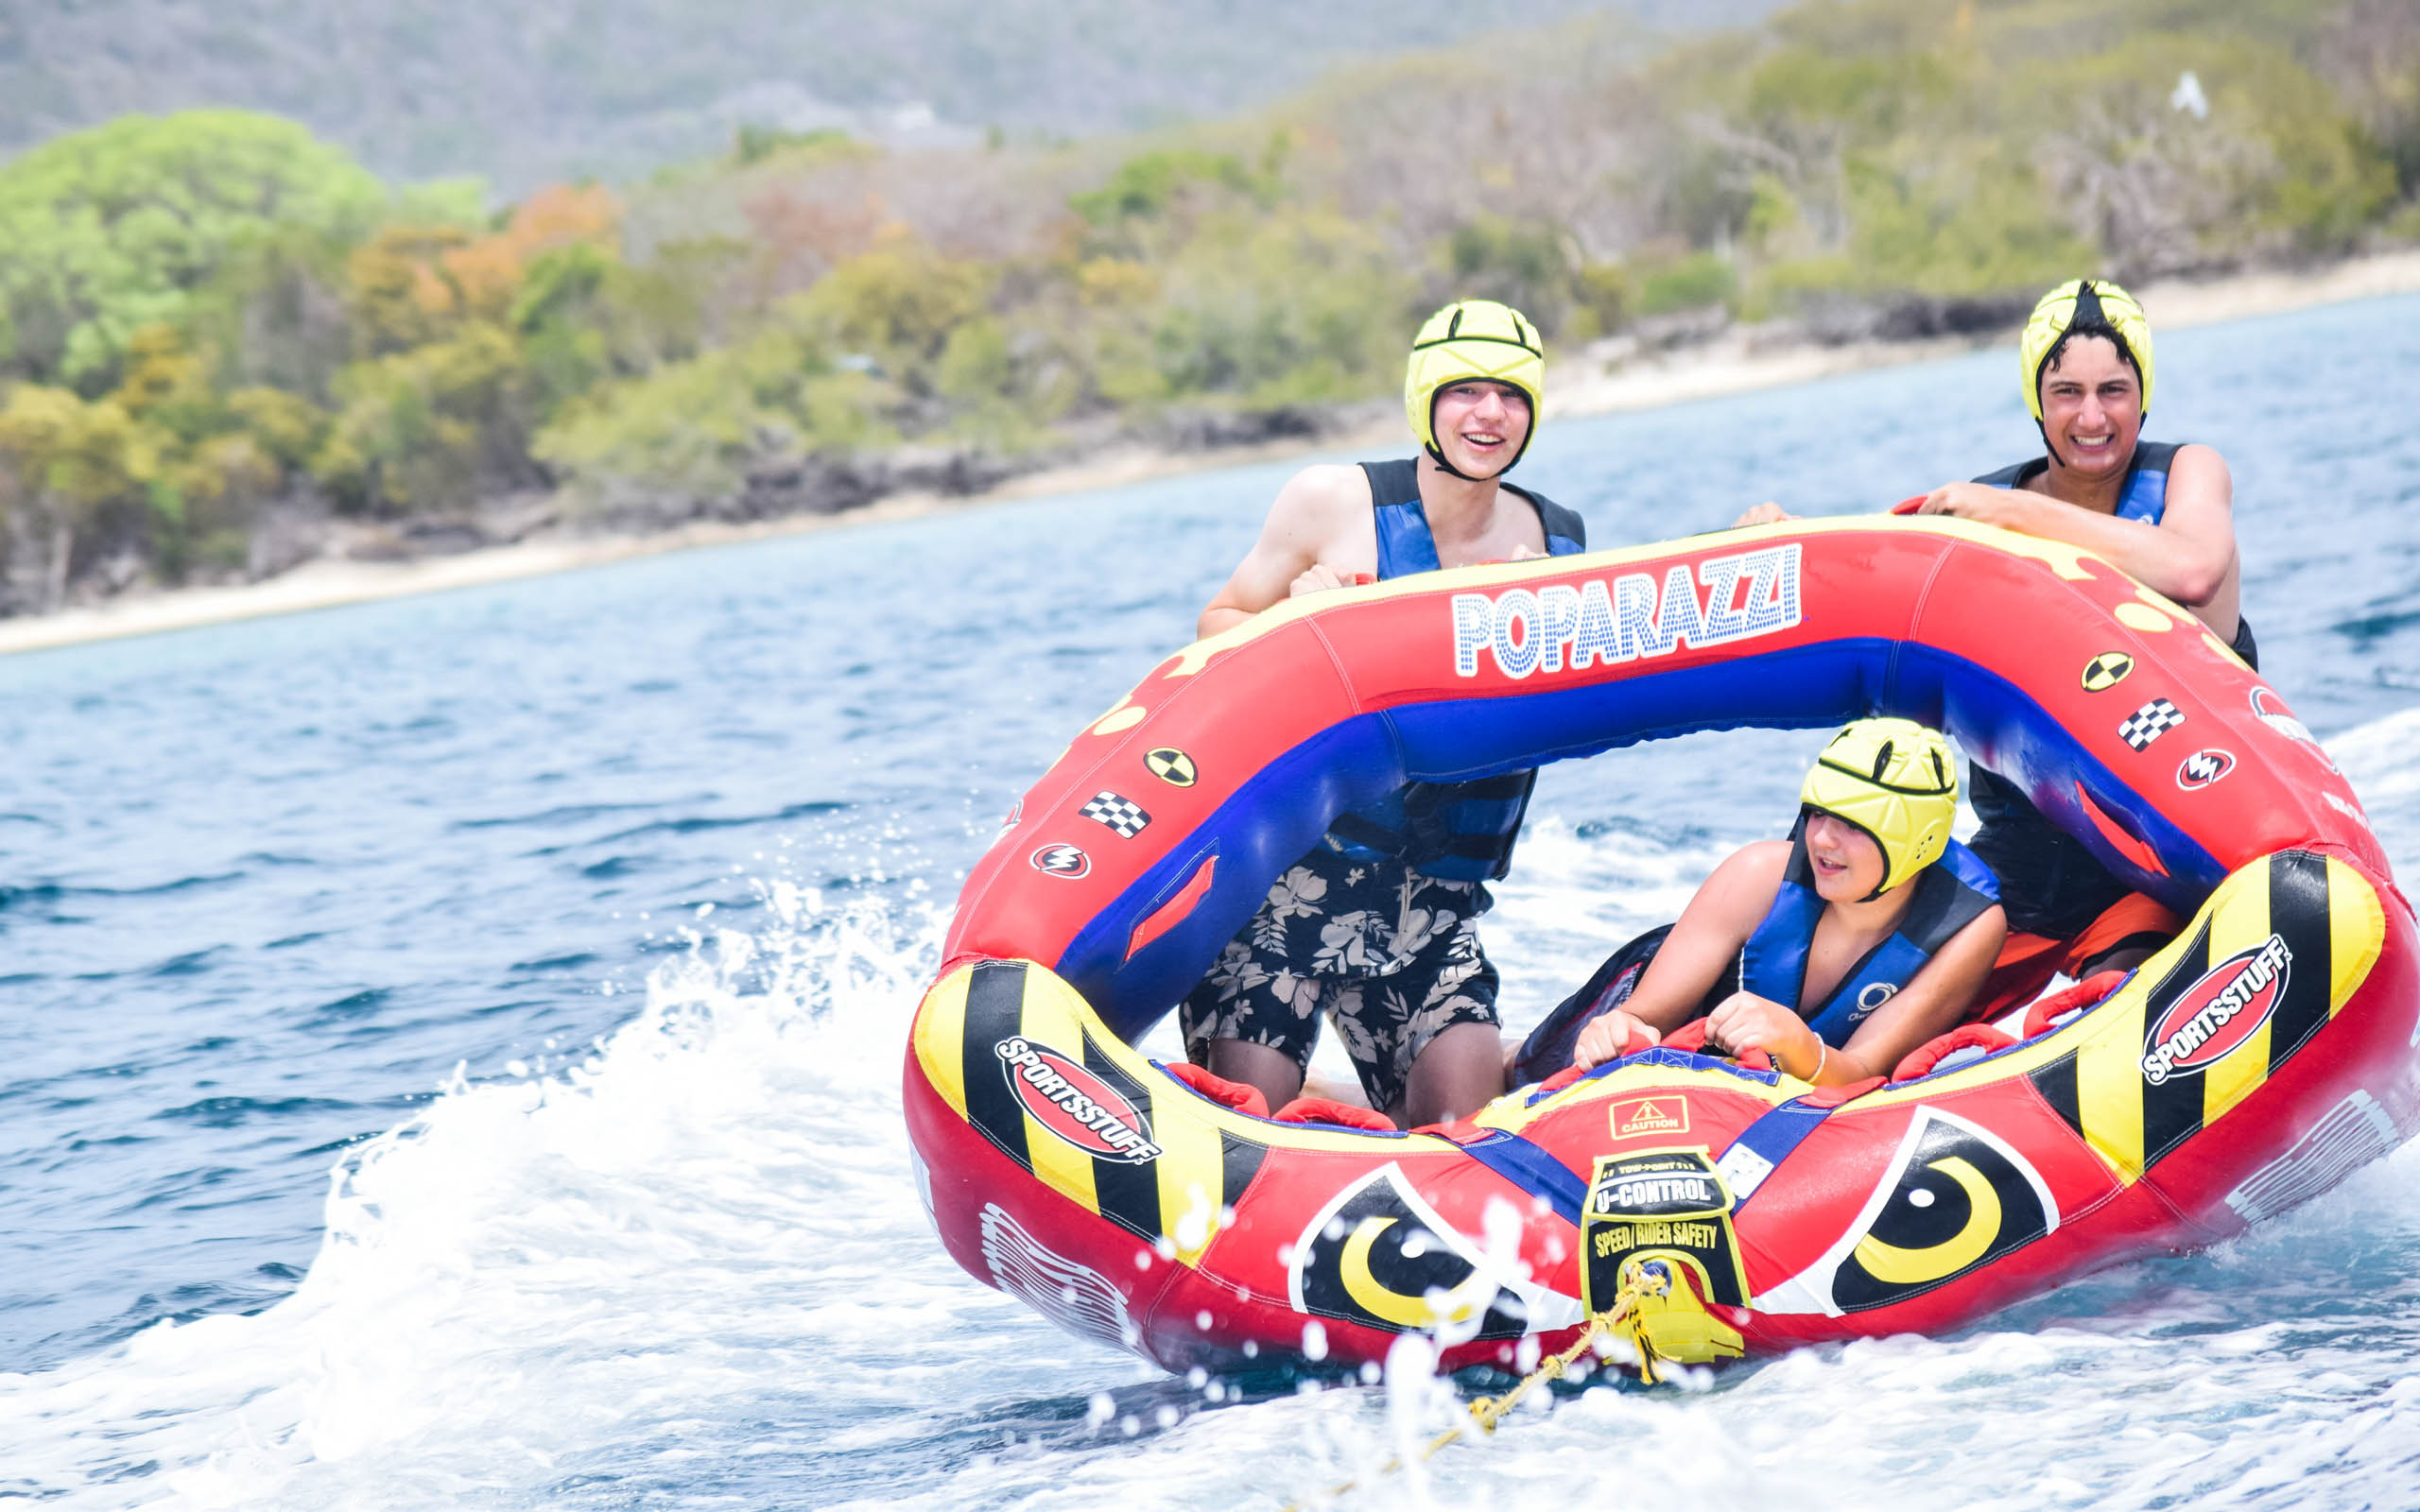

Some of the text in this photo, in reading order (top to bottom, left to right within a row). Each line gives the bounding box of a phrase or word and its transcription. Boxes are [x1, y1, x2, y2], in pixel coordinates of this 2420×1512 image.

[1451, 543, 1803, 679] POPARAZZI
[2140, 936, 2288, 1083] SPORTSSTUFF
[997, 1038, 1162, 1160] SPORTSSTUFF
[1621, 1119, 1679, 1133] CAUTION
[1597, 1178, 1711, 1213] U-CONTROL
[1672, 1222, 1718, 1249] SAFETY
